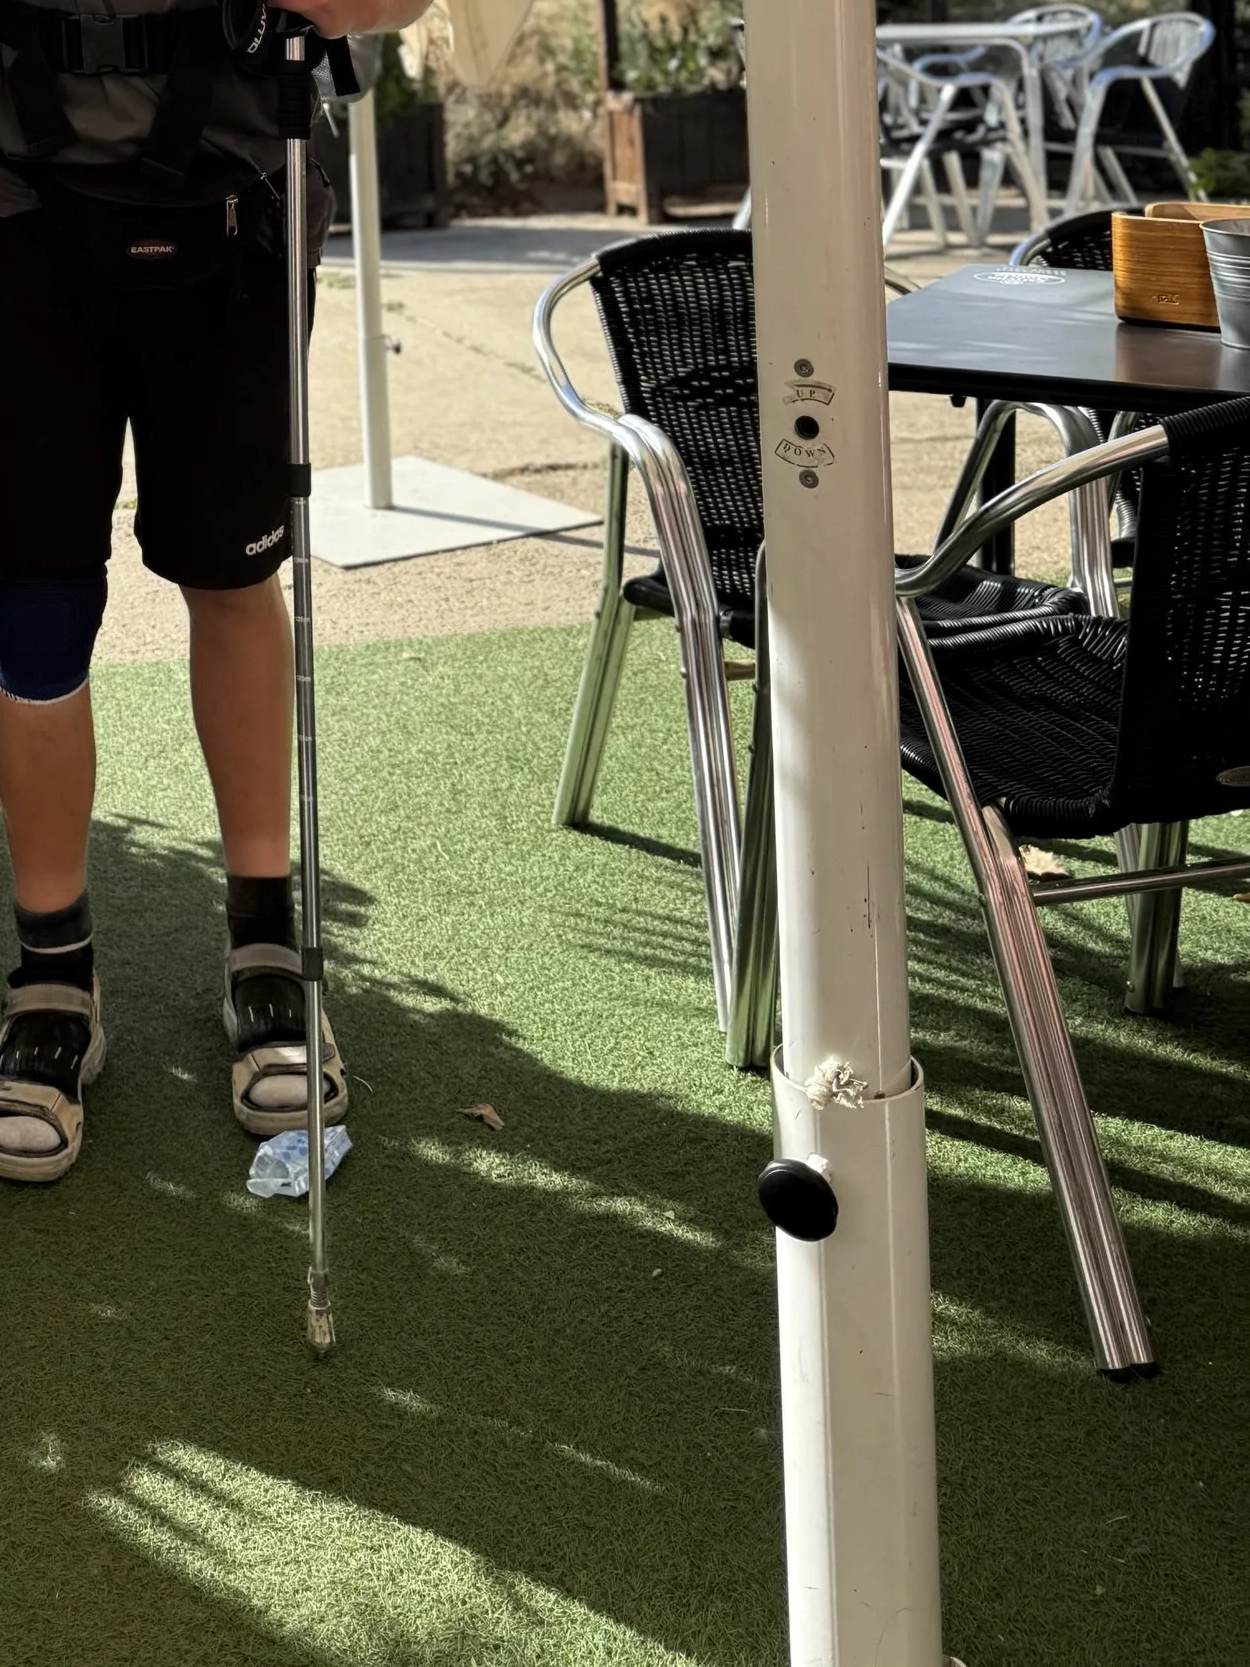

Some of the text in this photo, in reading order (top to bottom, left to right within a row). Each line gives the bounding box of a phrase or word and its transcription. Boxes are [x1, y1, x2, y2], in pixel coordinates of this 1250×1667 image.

[130, 245, 173, 254] EASTPAK
[796, 389, 816, 398] UP
[783, 443, 826, 458] DOWN
[245, 525, 285, 556] adidas
